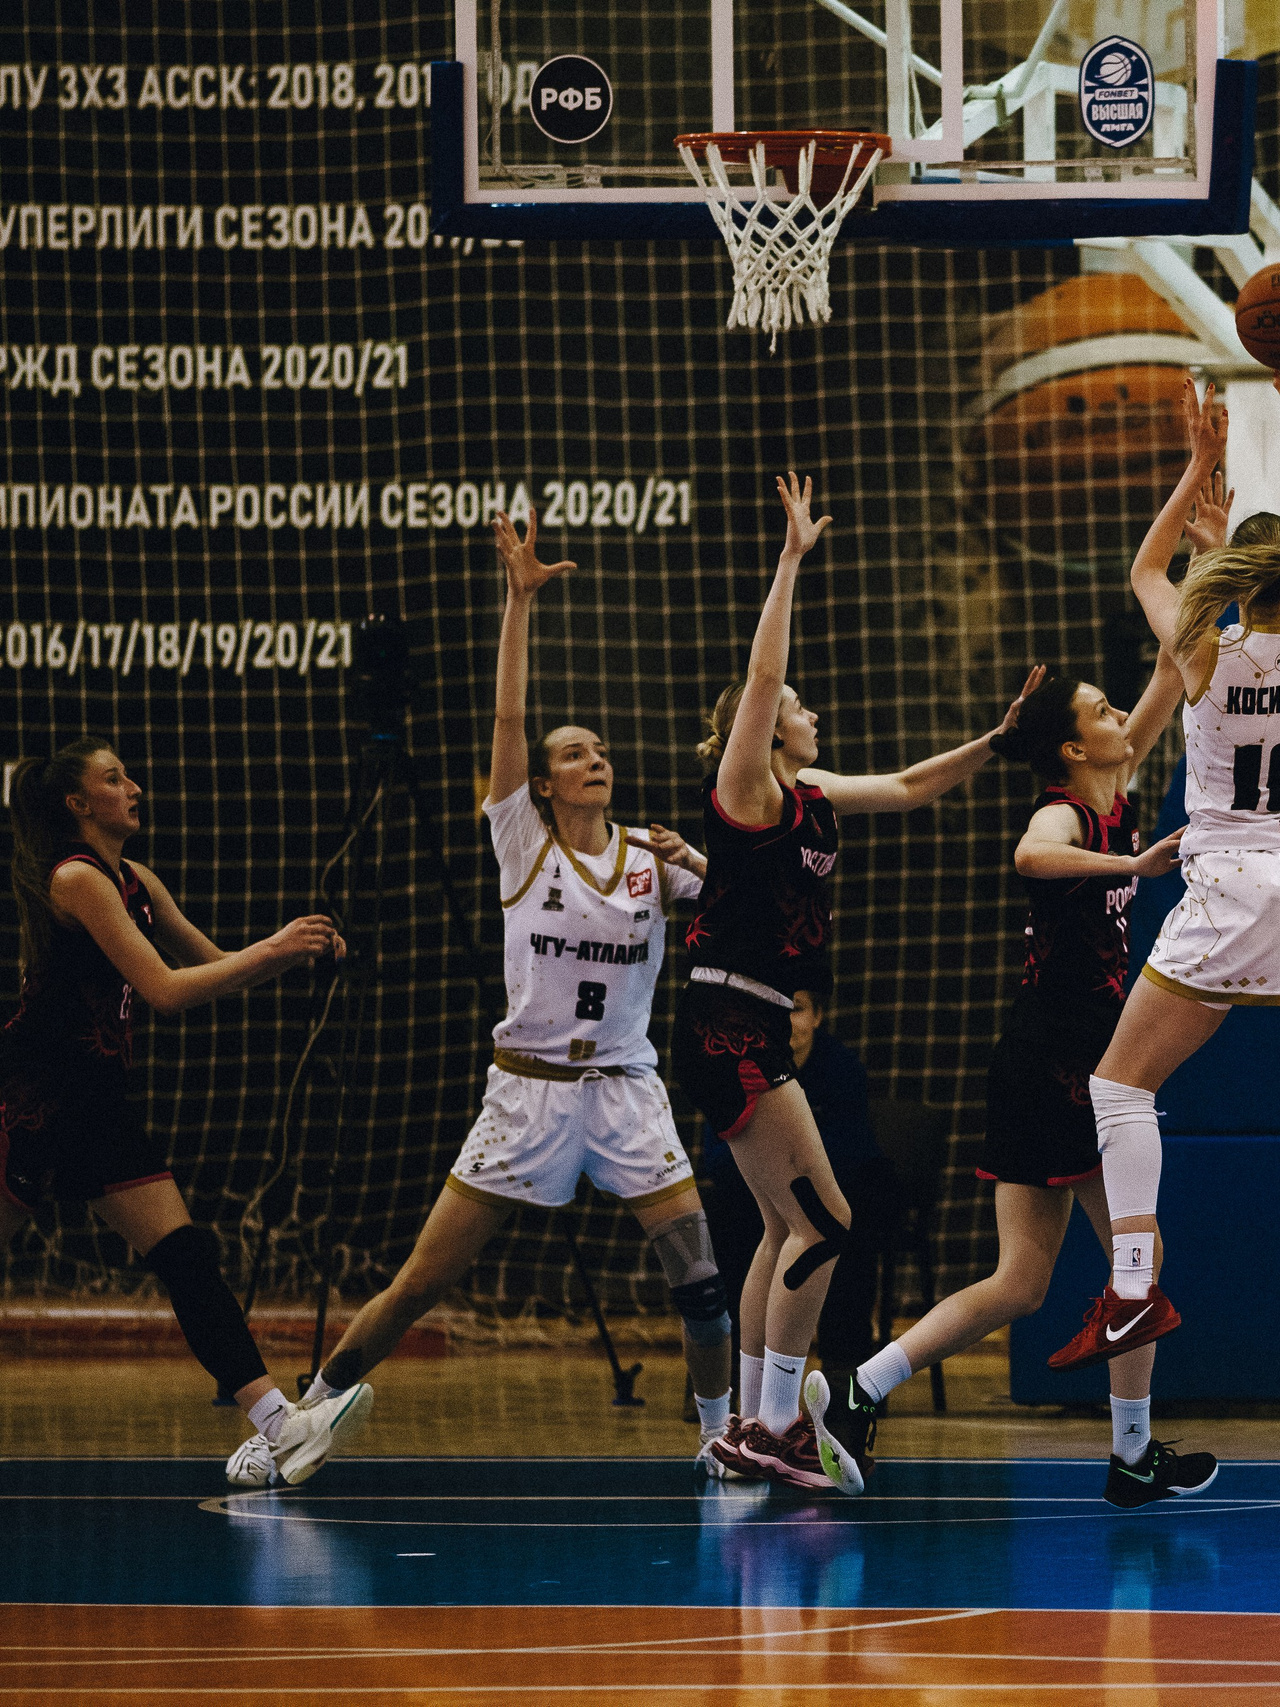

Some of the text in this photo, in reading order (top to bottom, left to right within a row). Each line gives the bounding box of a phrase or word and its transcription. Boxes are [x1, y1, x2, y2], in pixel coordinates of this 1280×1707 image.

[136, 64, 260, 110] АССК:
[266, 62, 365, 113] 2018,
[374, 62, 432, 110] 201
[540, 87, 602, 111] РФБ
[1098, 89, 1135, 98] FONBET
[1091, 102, 1143, 121] ВЫСШАЯ
[1100, 122, 1135, 132] ЛИГА
[213, 203, 375, 251] СЕЗОНА
[90, 344, 253, 391] СЕЗОНА
[260, 339, 409, 397] 2020/21
[208, 483, 371, 530] РОССИИ
[379, 481, 537, 529] СЕЗОНА
[542, 477, 692, 534] 2020/21
[0, 618, 352, 677] 016/17/18/19/20/21
[530, 932, 649, 965] ЧГУ-АТЛАНТА
[575, 980, 608, 1021] 8
